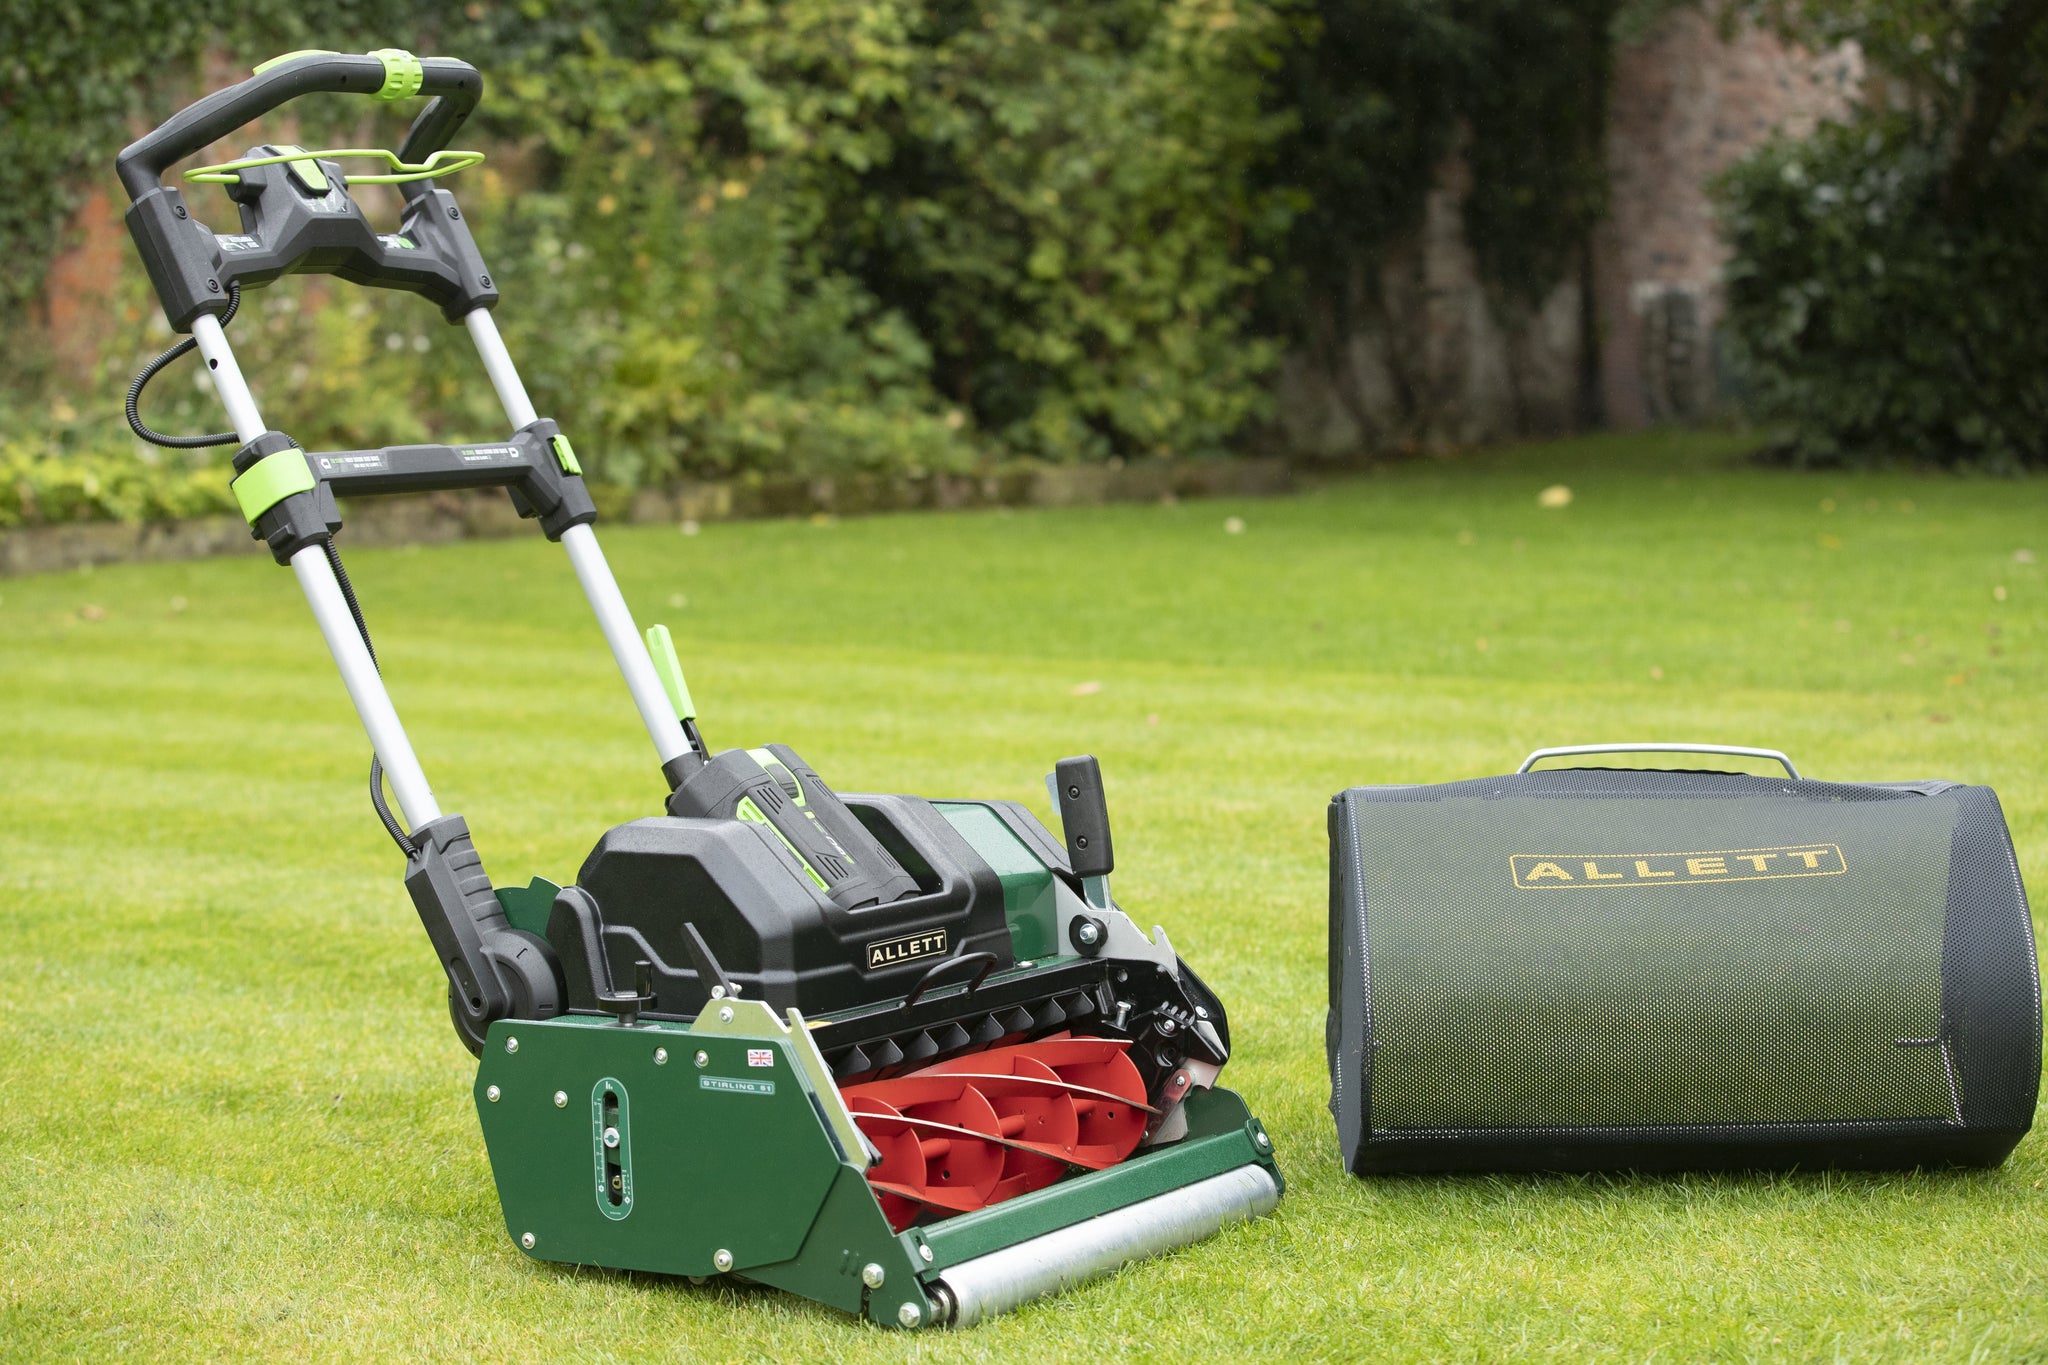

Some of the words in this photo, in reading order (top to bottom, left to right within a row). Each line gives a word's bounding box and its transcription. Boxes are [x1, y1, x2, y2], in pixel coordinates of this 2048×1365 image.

[1525, 850, 1828, 880] ALLETT
[872, 935, 944, 964] ALLETT
[703, 1080, 755, 1091] STIRLING
